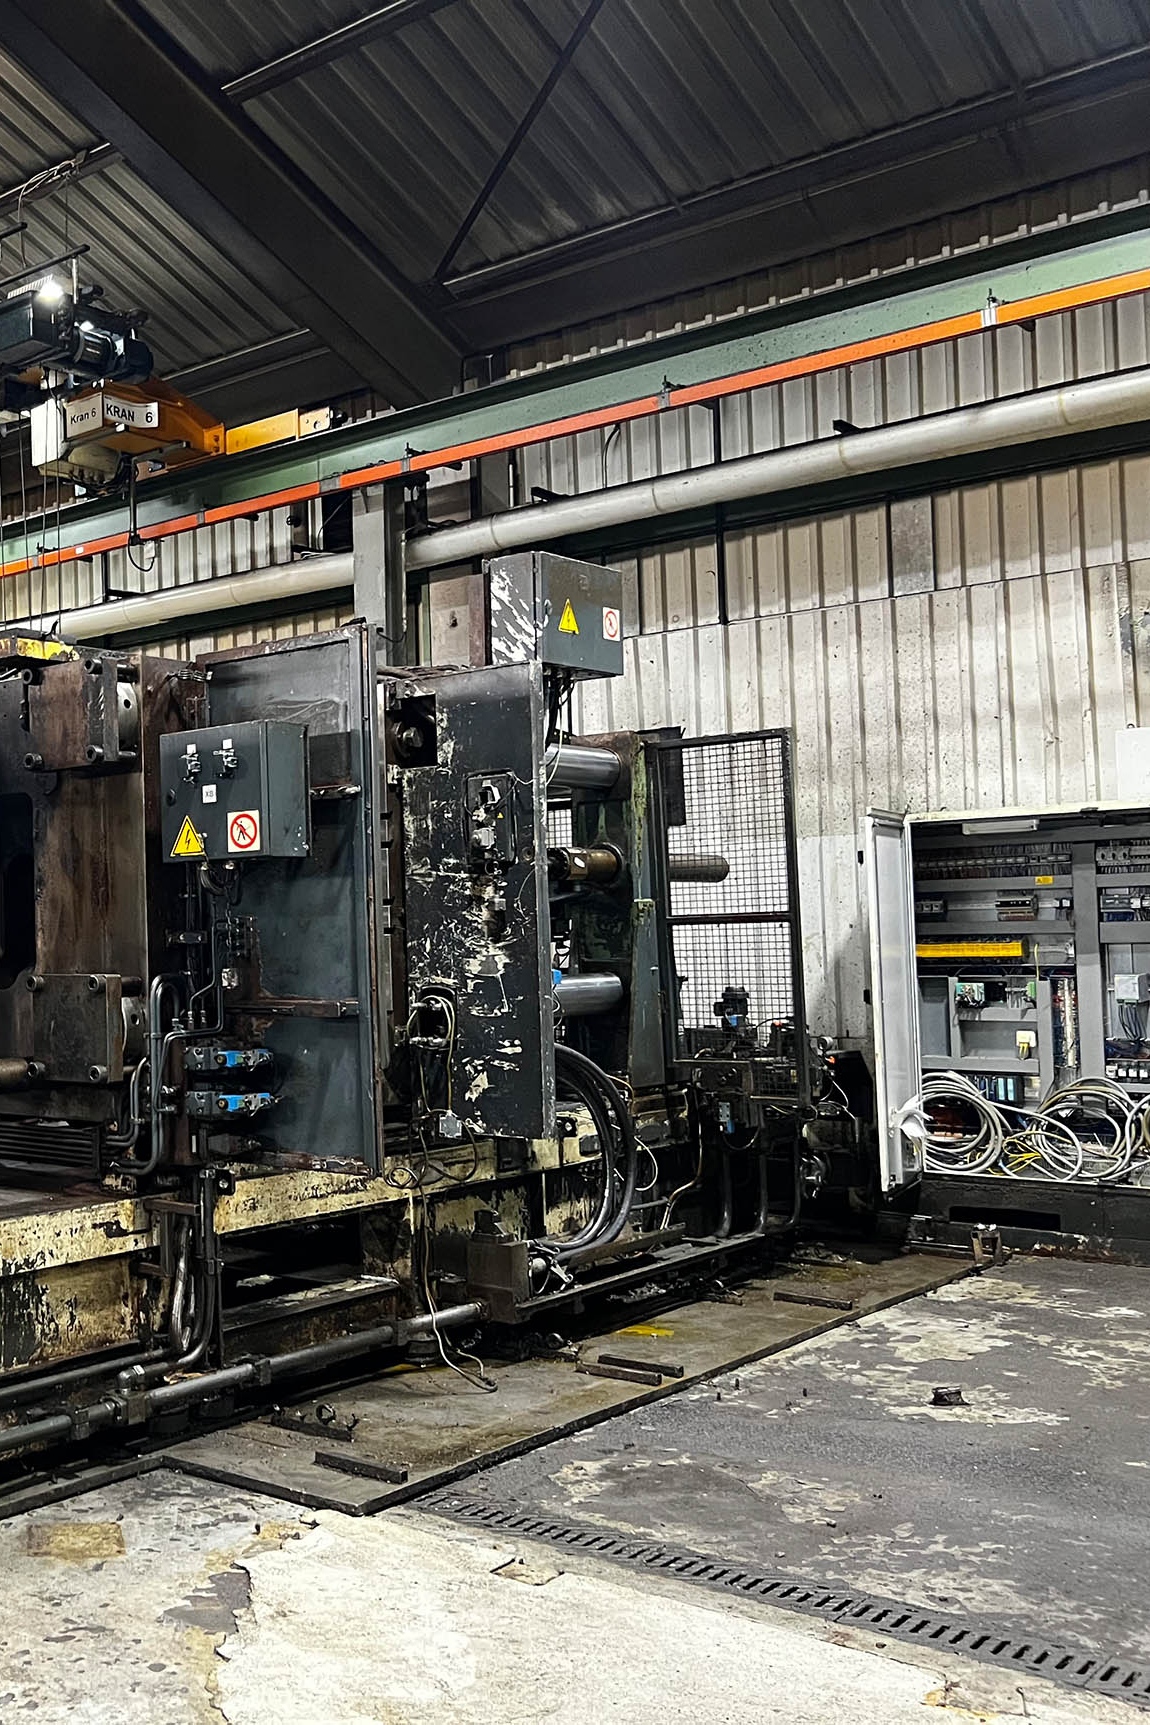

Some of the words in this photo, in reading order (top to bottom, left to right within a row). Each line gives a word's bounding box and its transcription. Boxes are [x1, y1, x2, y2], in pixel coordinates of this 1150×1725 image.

[70, 411, 90, 424] Kran
[91, 407, 97, 418] 6
[106, 403, 135, 422] KRAN
[145, 412, 153, 423] 6
